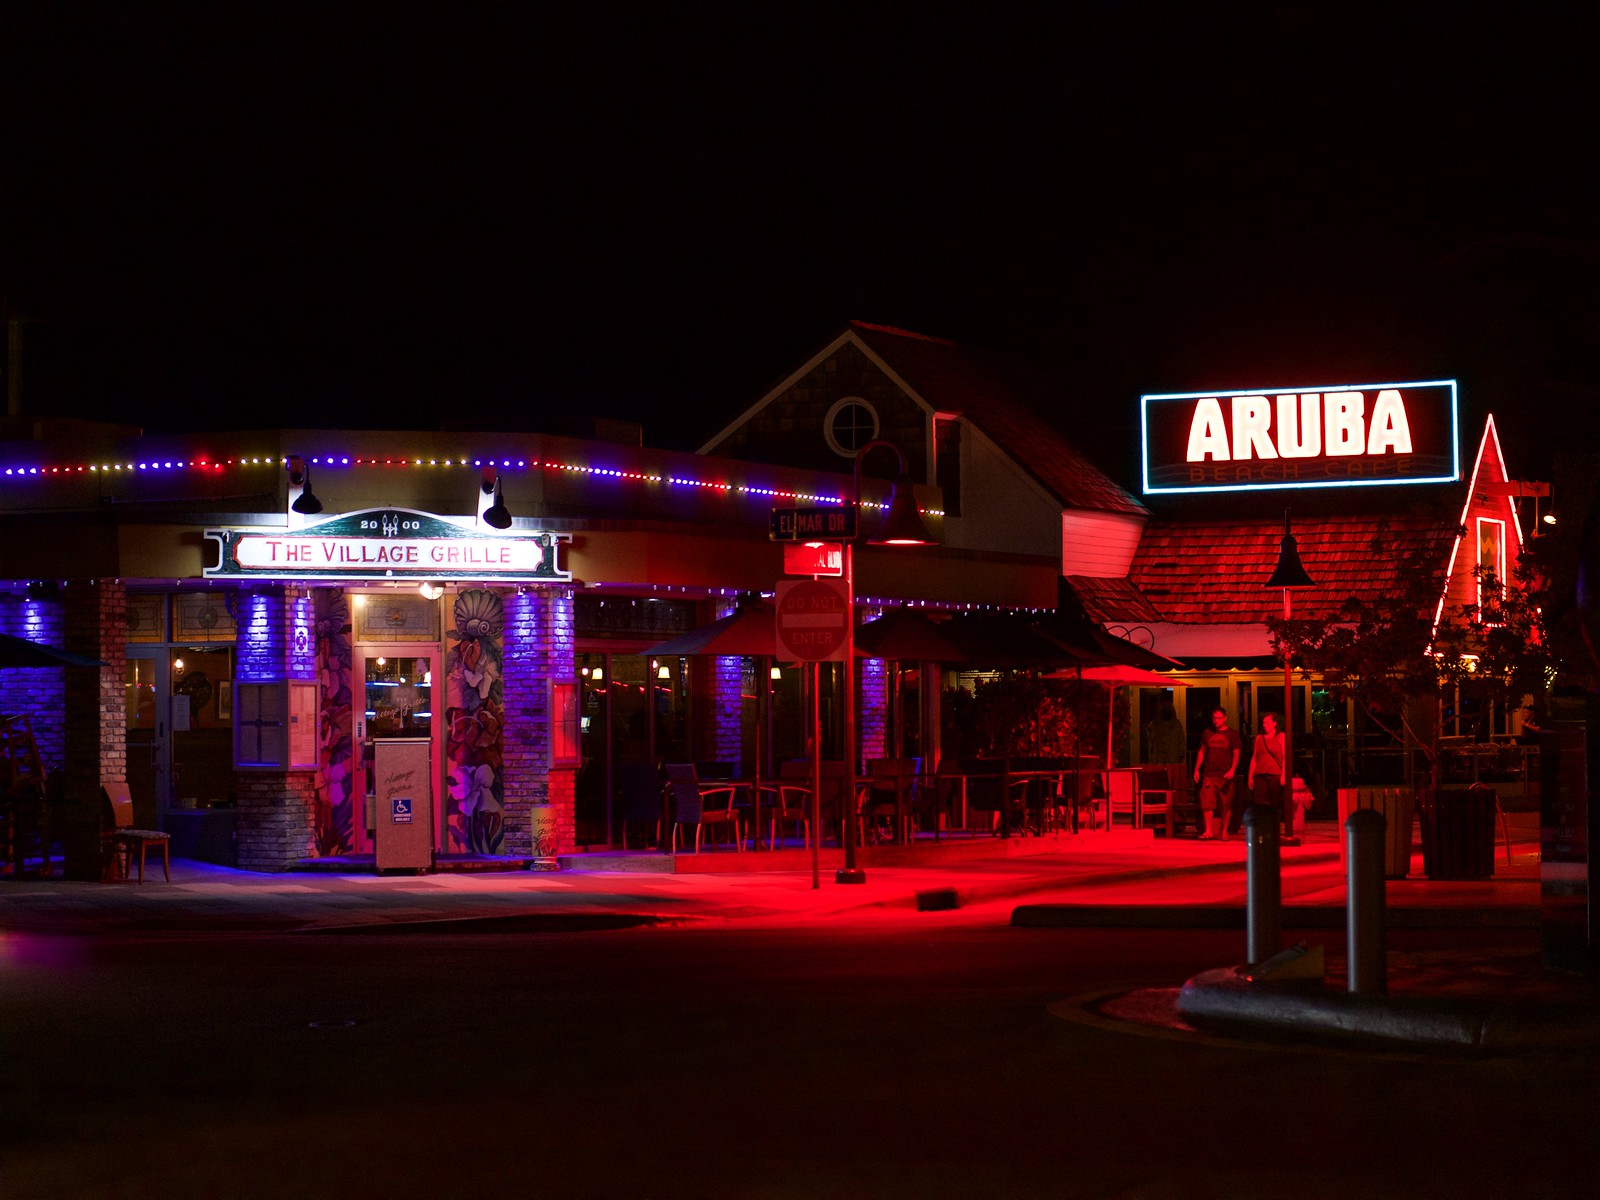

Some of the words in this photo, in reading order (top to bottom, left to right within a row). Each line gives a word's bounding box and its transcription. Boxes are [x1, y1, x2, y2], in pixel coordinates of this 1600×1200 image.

[1186, 389, 1413, 462] ARUBA
[1189, 463, 1299, 481] BEACH
[798, 514, 822, 532] MAR
[828, 513, 845, 531] DR
[266, 541, 312, 561] THE
[321, 542, 418, 563] VILLAGE
[430, 545, 511, 562] GRILLE
[788, 598, 804, 609] DO
[811, 597, 838, 608] NOT
[792, 632, 832, 644] ENTER
